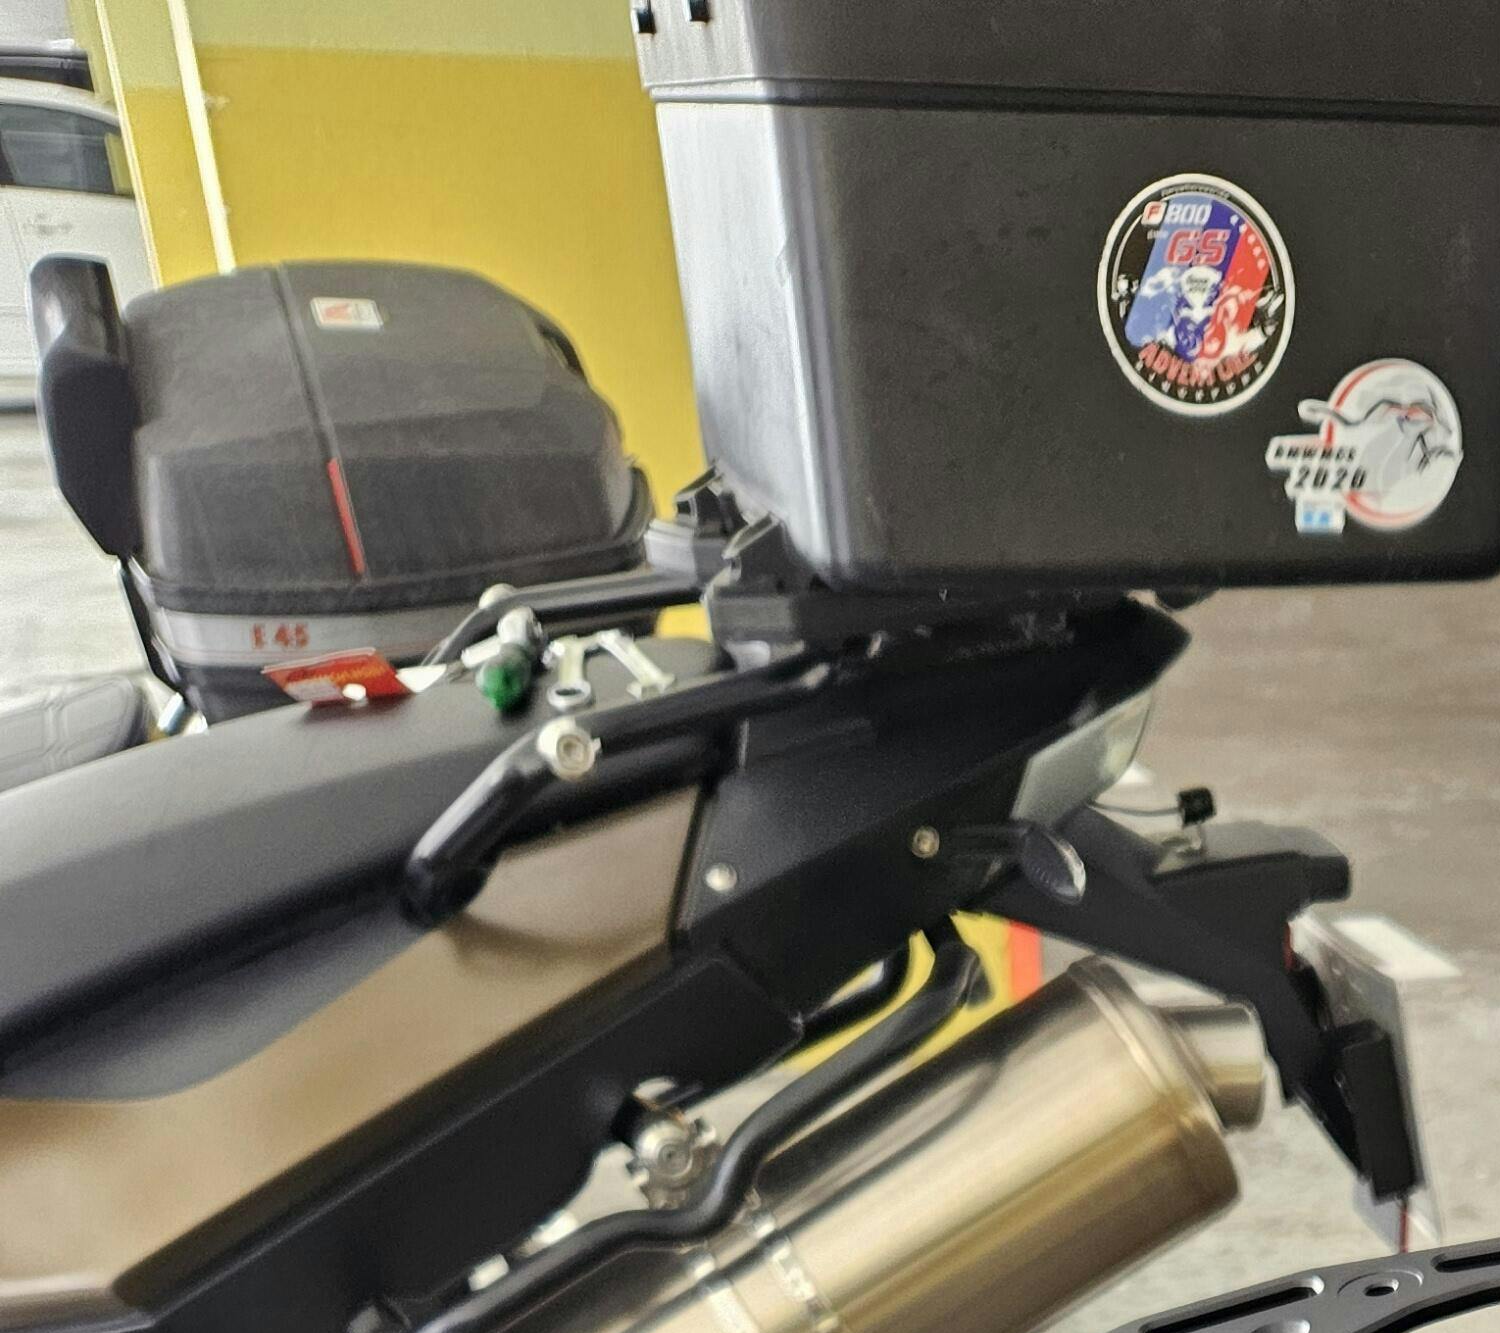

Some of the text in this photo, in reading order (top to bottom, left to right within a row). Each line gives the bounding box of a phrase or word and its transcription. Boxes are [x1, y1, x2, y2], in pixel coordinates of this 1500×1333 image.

[1147, 203, 1213, 226] F 800
[1165, 228, 1231, 266] GS
[1294, 466, 1366, 490] 2020
